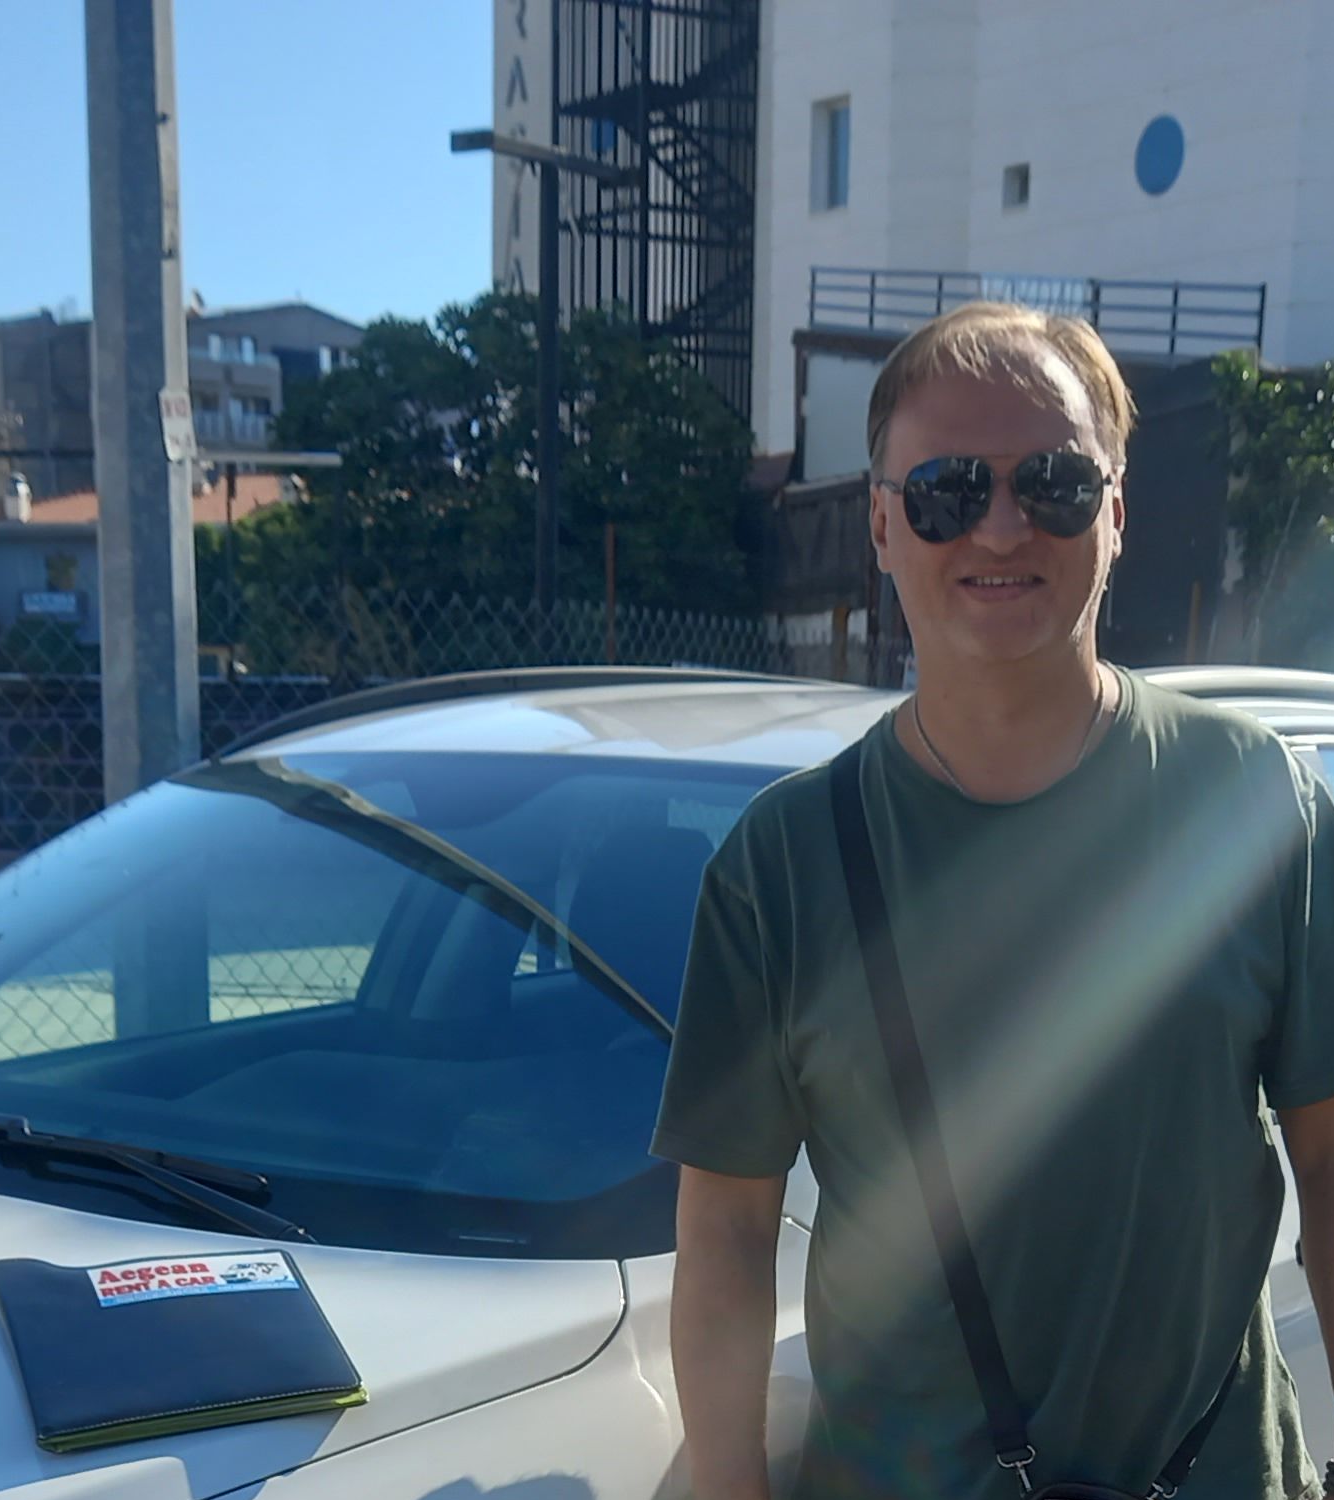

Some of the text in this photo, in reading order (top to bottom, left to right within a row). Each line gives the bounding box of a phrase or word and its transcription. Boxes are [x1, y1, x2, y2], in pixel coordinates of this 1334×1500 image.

[99, 1262, 210, 1284] Aegean
[99, 1280, 151, 1298] RENT
[157, 1277, 172, 1290] A
[175, 1275, 217, 1287] CAR
